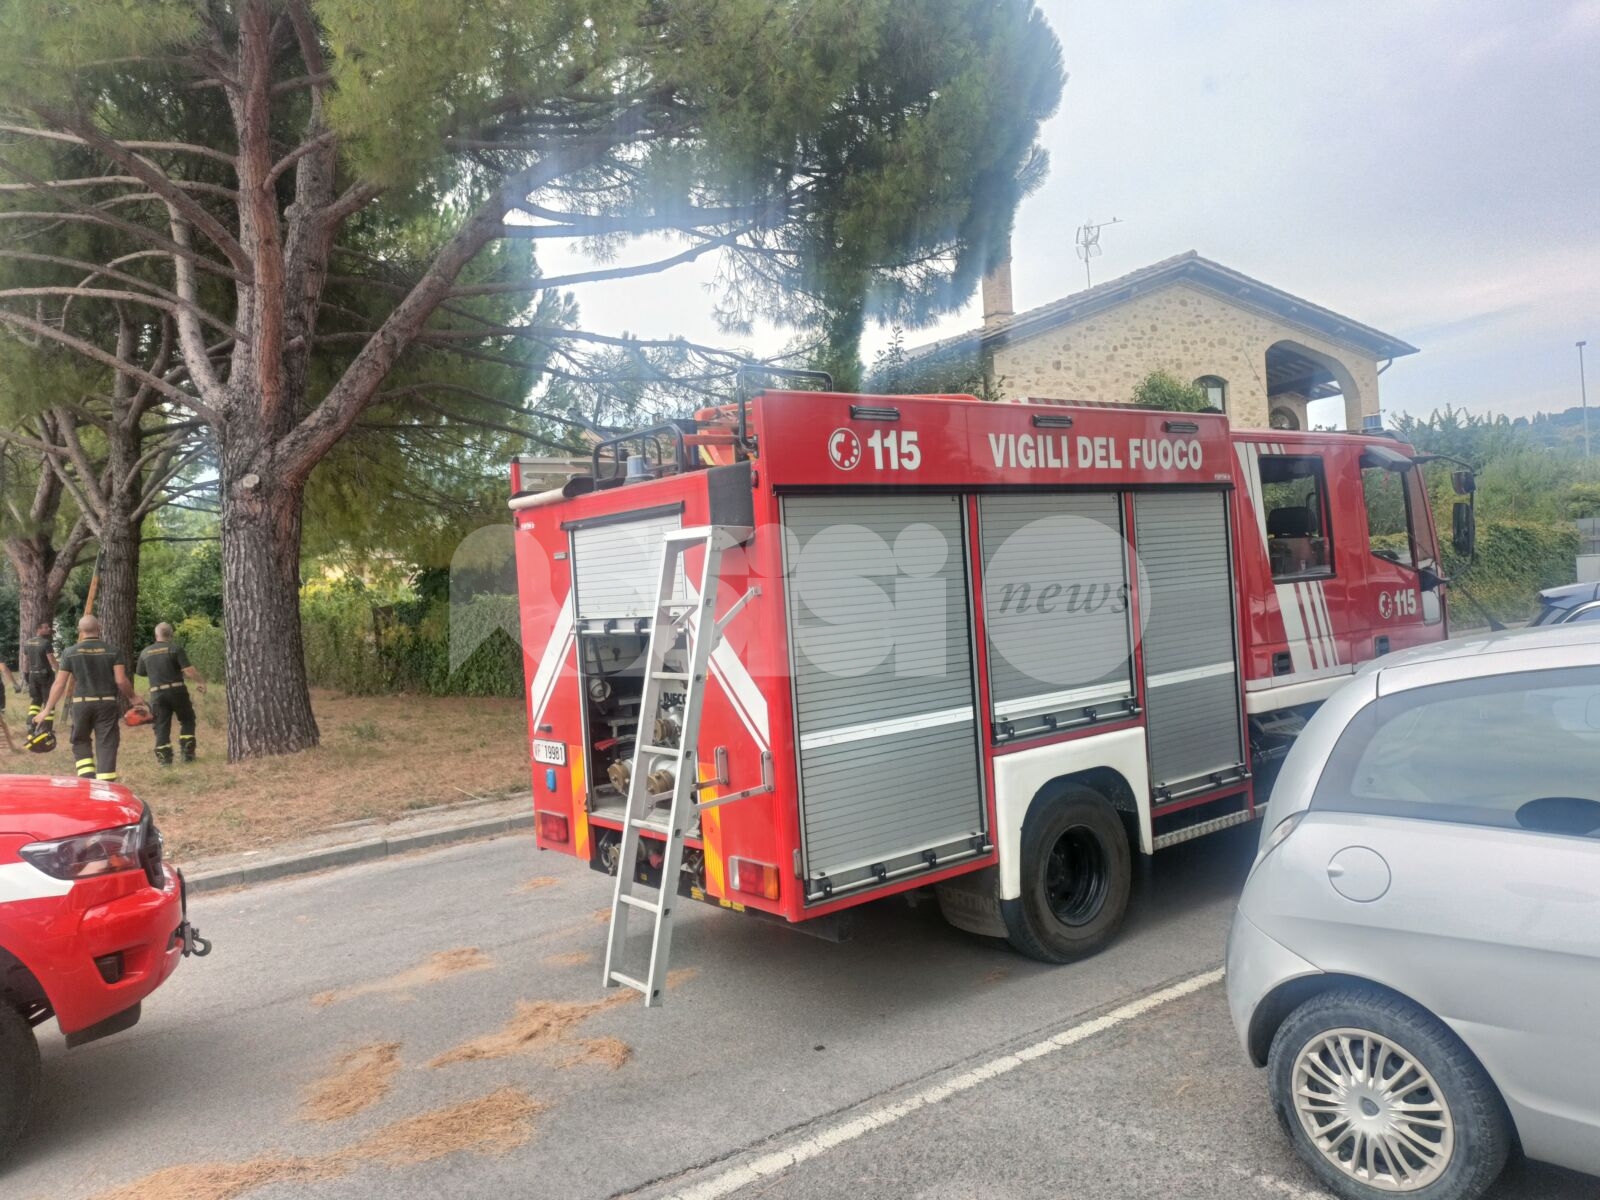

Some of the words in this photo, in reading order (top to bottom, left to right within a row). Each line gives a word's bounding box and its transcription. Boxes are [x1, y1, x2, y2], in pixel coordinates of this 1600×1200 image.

[867, 429, 922, 470] 115
[988, 433, 1070, 469] VIGILI
[1076, 435, 1123, 470] DEL
[1128, 438, 1203, 471] FUOCO
[1394, 588, 1417, 617] 115
[544, 745, 564, 761] 19981
